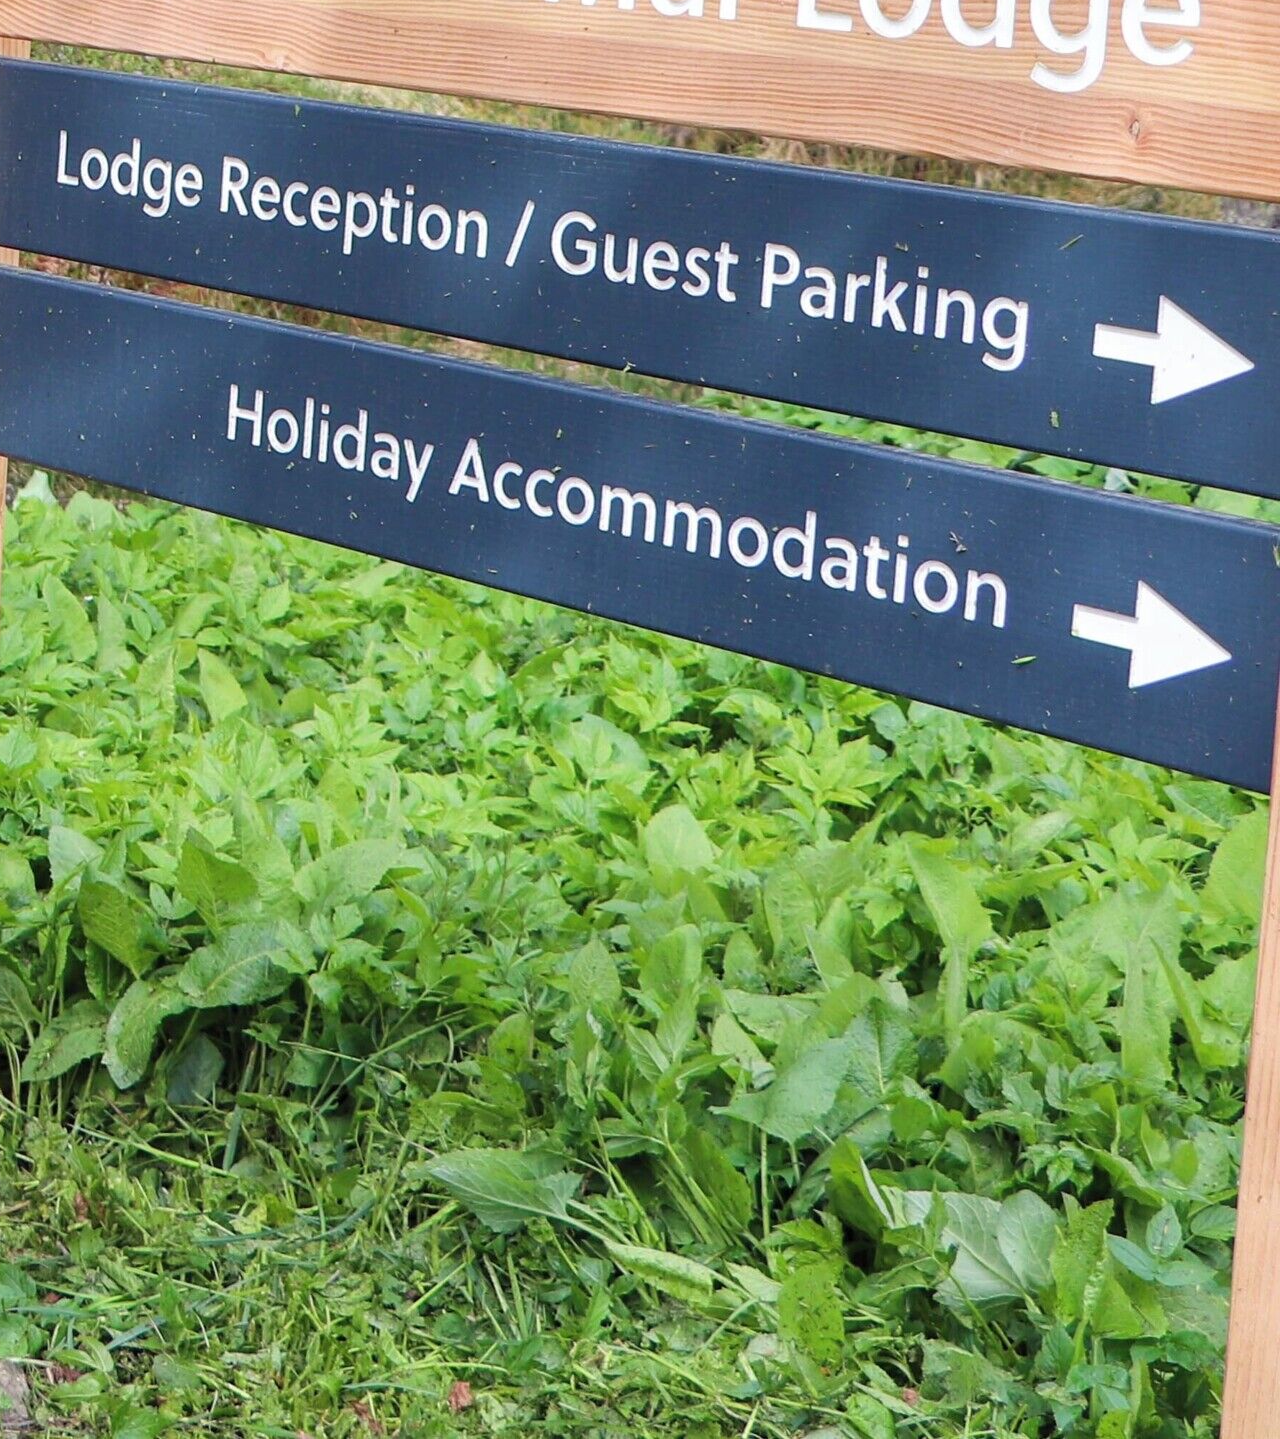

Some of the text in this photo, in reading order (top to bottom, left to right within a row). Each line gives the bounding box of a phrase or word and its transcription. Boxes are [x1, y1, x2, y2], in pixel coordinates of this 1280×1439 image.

[57, 131, 1030, 369] Lodge Reception / Guest Parking
[228, 384, 1010, 627] Holiday Accommodation
